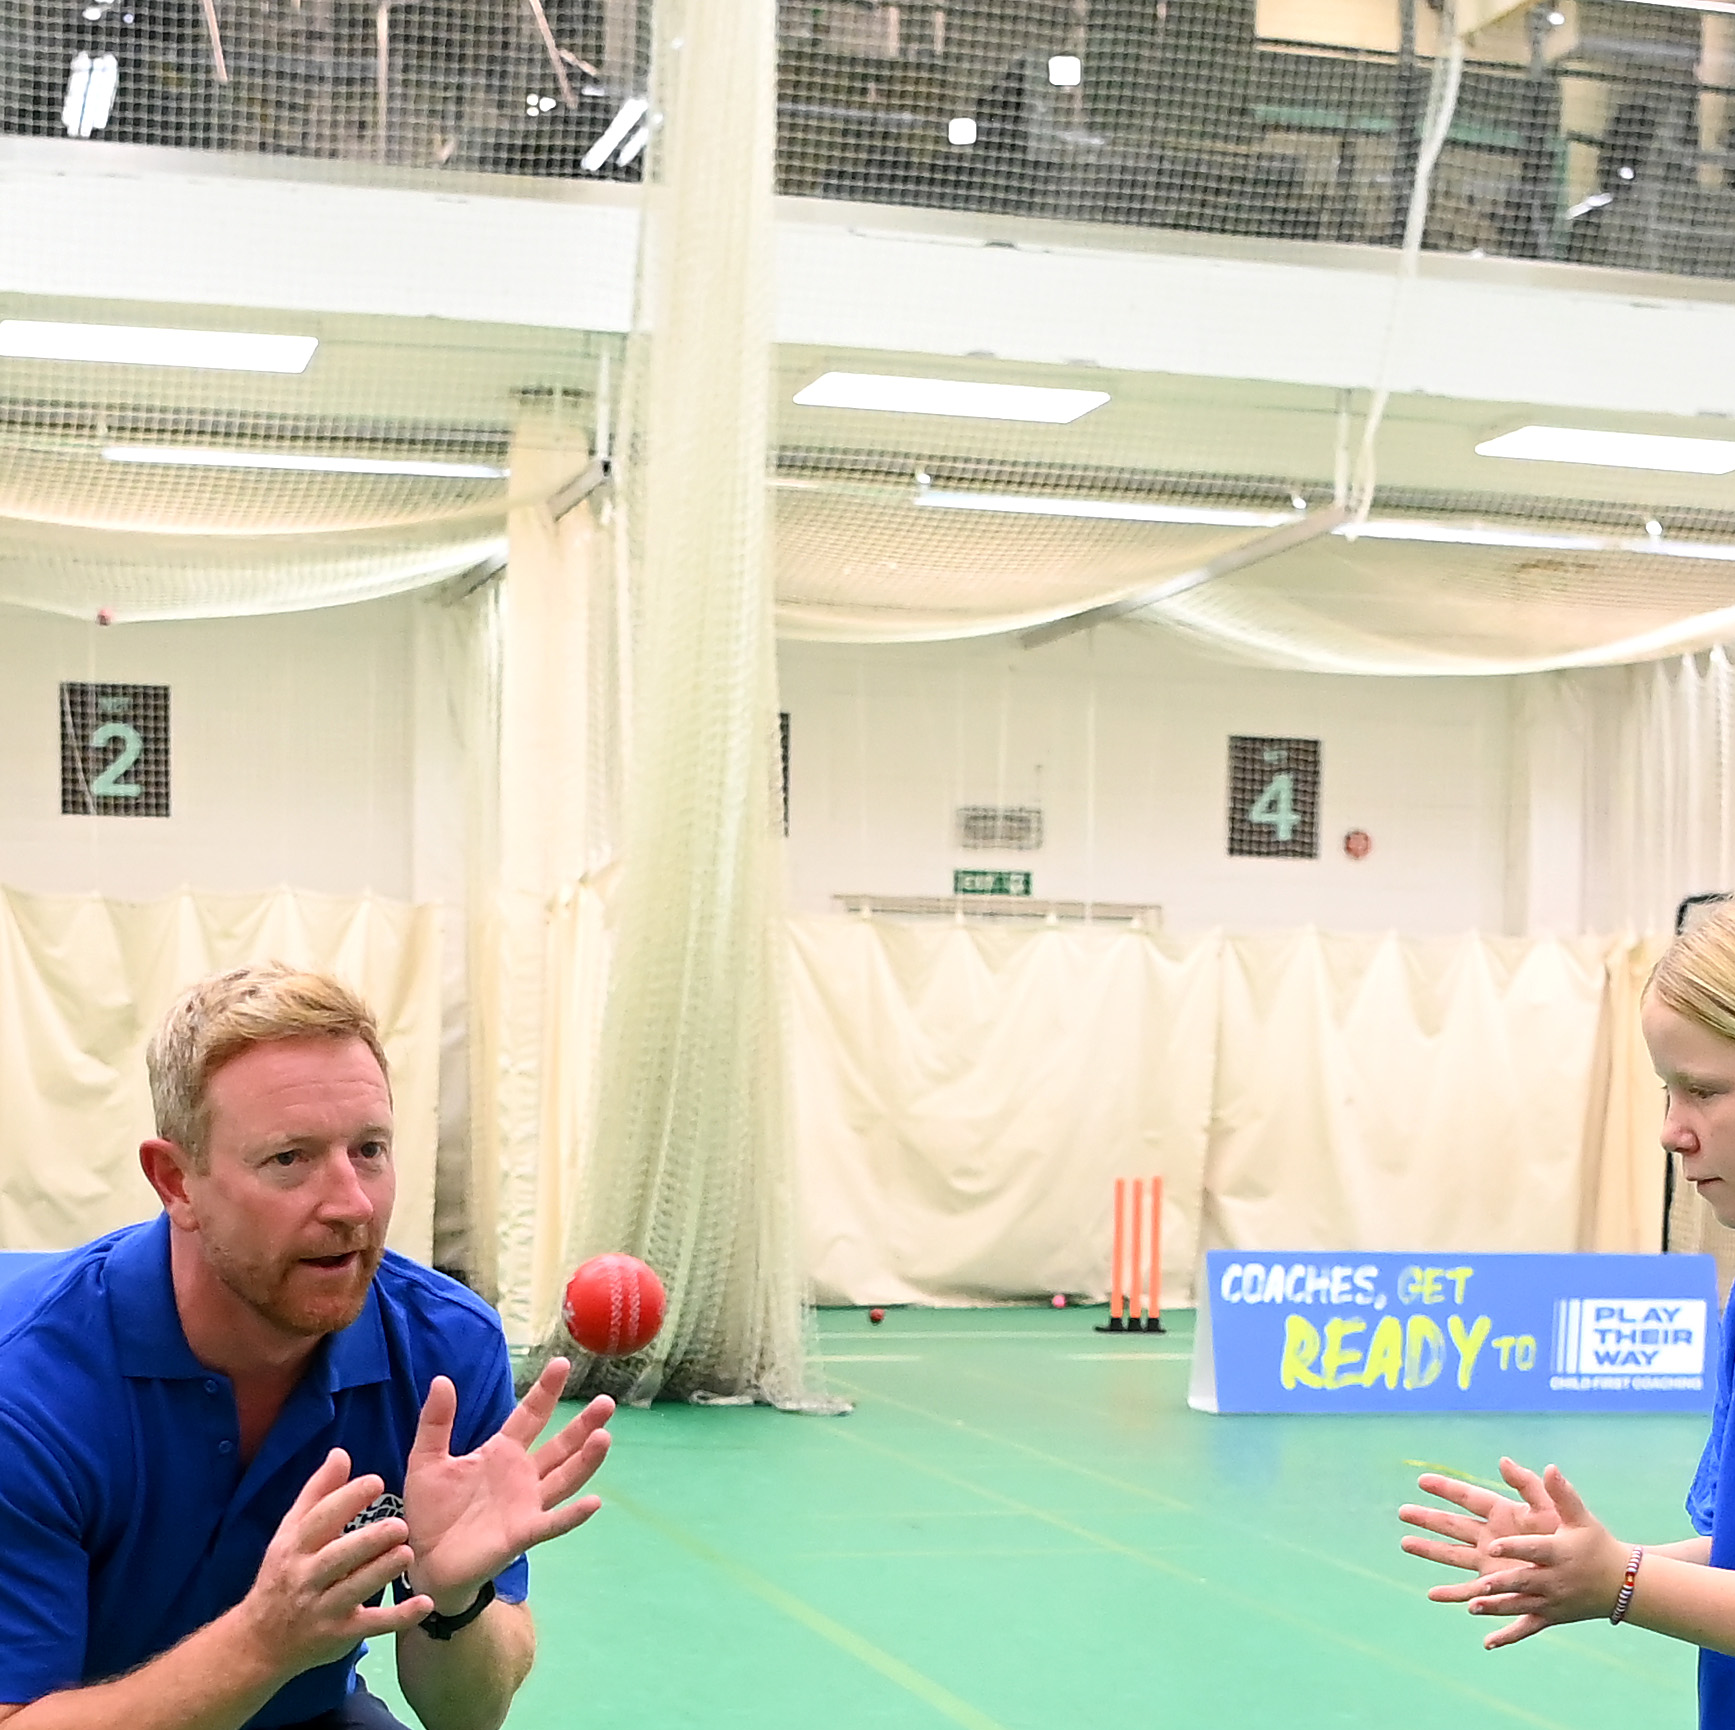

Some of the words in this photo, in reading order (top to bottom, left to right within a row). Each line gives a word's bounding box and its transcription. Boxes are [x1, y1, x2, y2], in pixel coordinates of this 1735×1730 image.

[92, 721, 143, 797] 2
[1249, 772, 1302, 841] 4
[1220, 1263, 1387, 1310] COACHES,
[1398, 1267, 1474, 1306] GET
[1595, 1307, 1682, 1323] PLAY
[1281, 1315, 1491, 1390] READY
[1492, 1336, 1537, 1371] TO
[1594, 1328, 1693, 1345] THEIR
[1594, 1350, 1660, 1366] WAY
[366, 1496, 404, 1513] LAY
